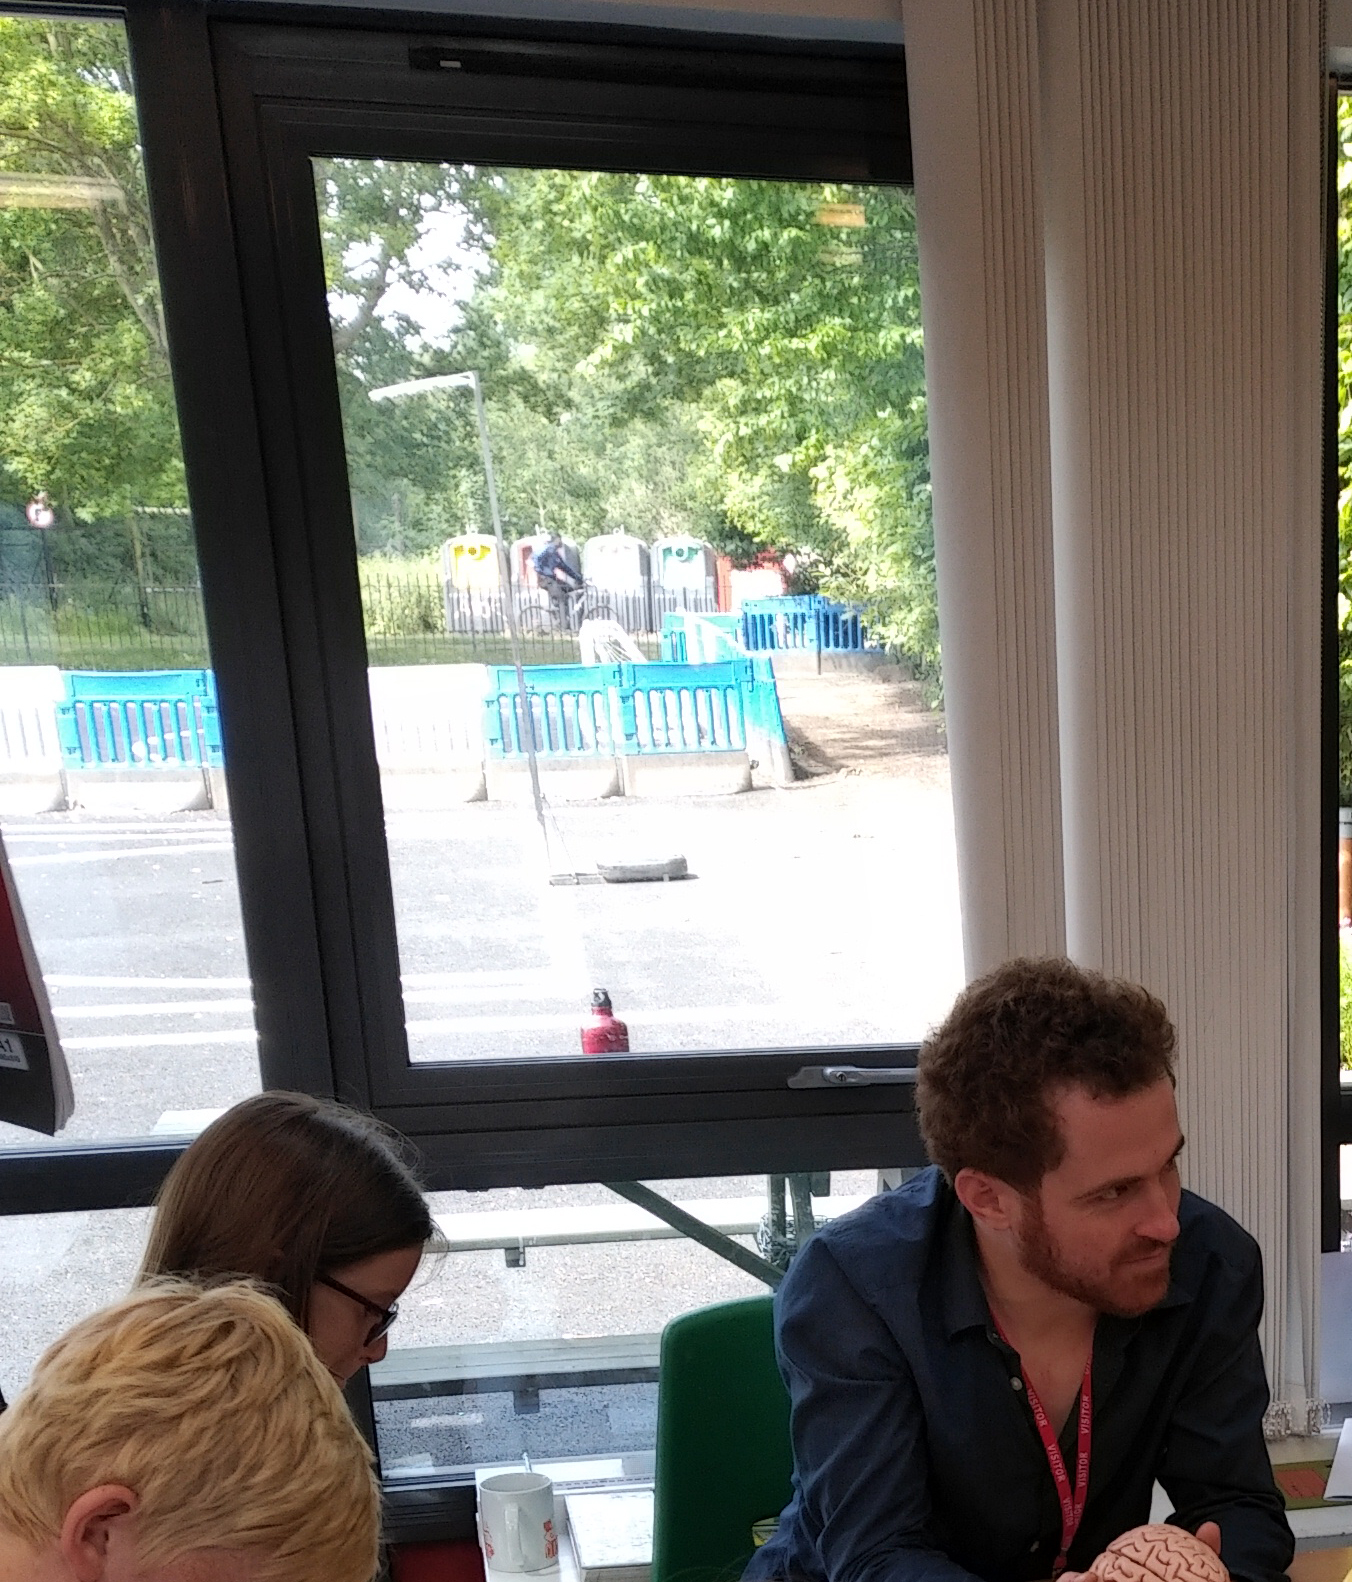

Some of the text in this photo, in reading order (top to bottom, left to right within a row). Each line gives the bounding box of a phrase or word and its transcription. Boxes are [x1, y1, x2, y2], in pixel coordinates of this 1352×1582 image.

[1027, 1387, 1048, 1428] VISITOR
[1048, 1443, 1066, 1483] VISITOR
[1081, 1394, 1091, 1435] VISITOR
[1078, 1451, 1089, 1488] VISITOR
